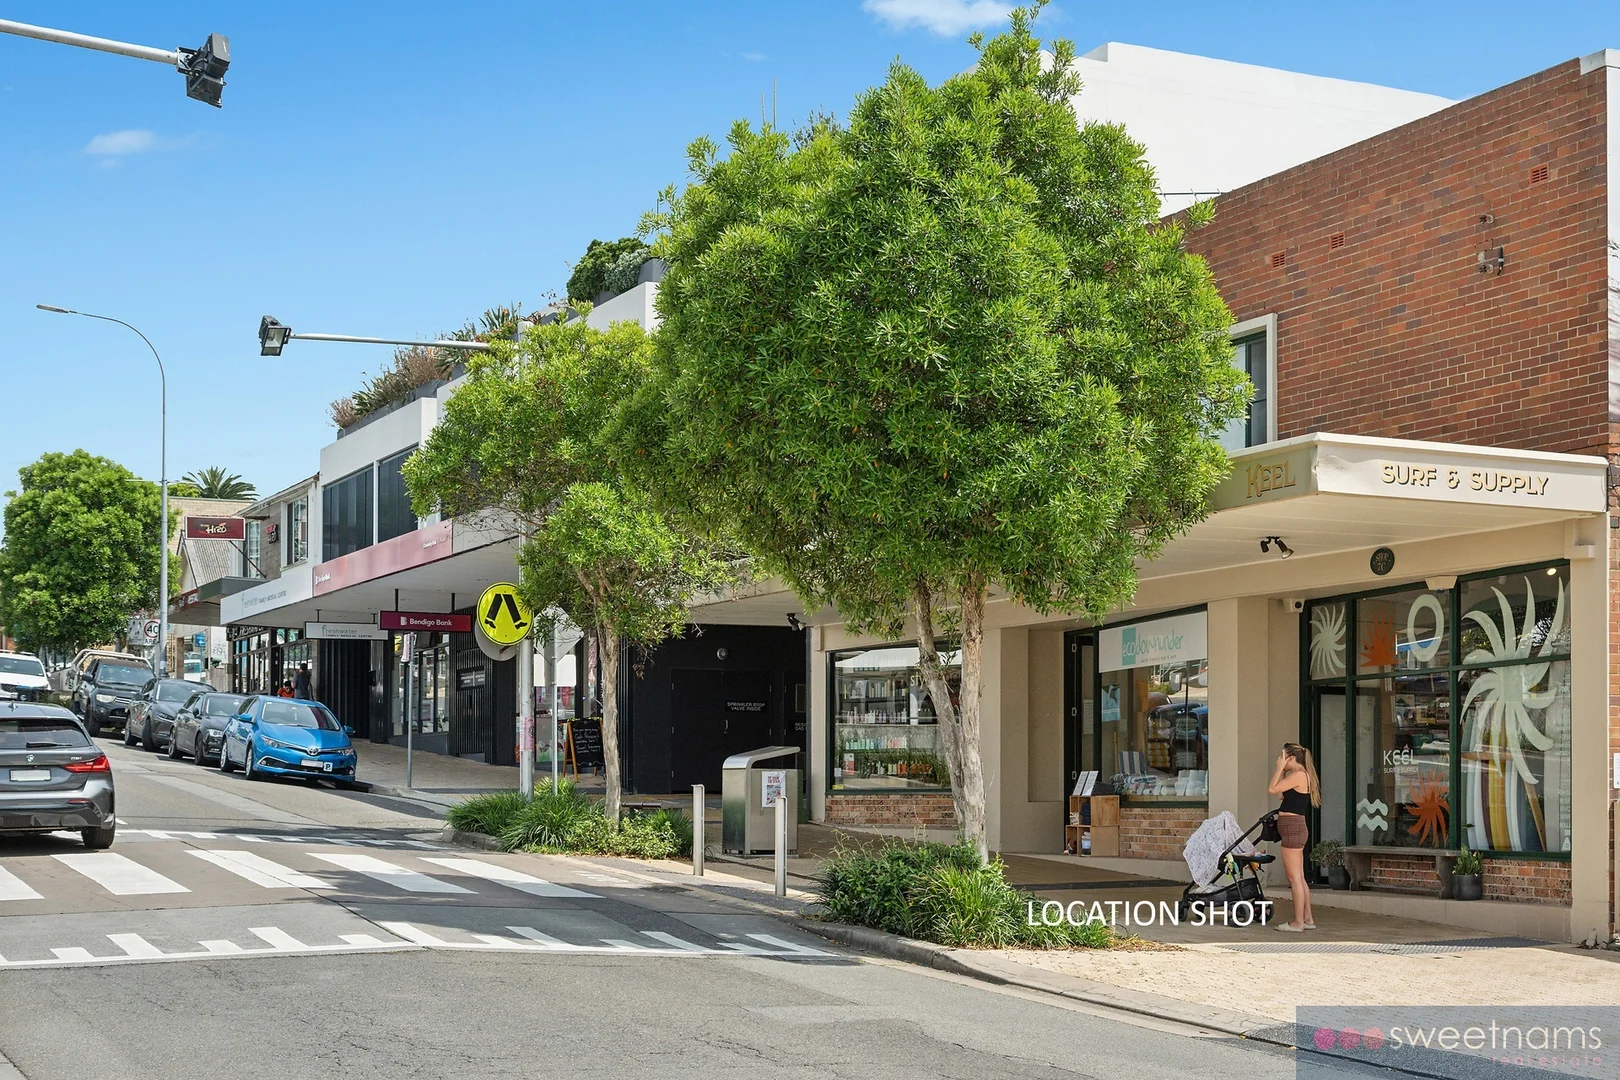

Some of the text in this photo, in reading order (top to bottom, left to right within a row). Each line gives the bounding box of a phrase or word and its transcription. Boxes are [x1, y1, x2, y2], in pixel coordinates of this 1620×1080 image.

[1246, 459, 1296, 498] KEEL
[1380, 464, 1549, 495] SURF & SUPPLY
[321, 624, 358, 637] freshwater
[409, 618, 453, 627] Bendigo Bank
